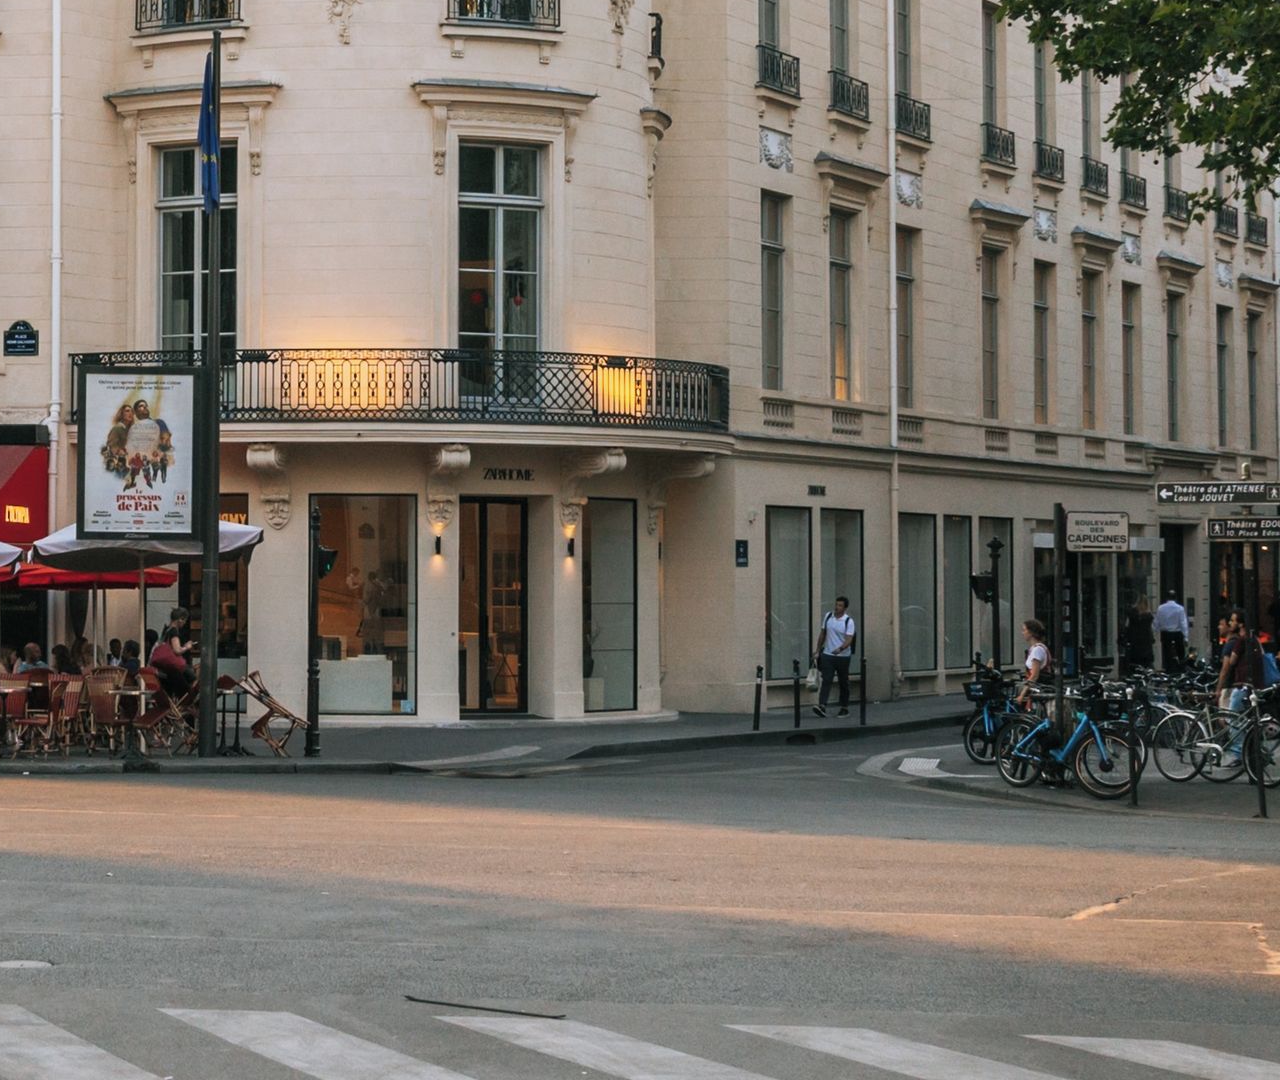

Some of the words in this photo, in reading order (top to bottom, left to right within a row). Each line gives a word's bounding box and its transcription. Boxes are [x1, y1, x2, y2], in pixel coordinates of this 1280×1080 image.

[1173, 484, 1205, 493] Théâtre
[1207, 484, 1217, 493] de
[116, 494, 162, 503] processus
[1173, 494, 1196, 502] Louis
[1200, 493, 1235, 502] JOUVET
[117, 501, 132, 511] de
[134, 501, 160, 511] Paix
[1238, 529, 1259, 537] Place
[1067, 534, 1127, 543] CAPUCINES
